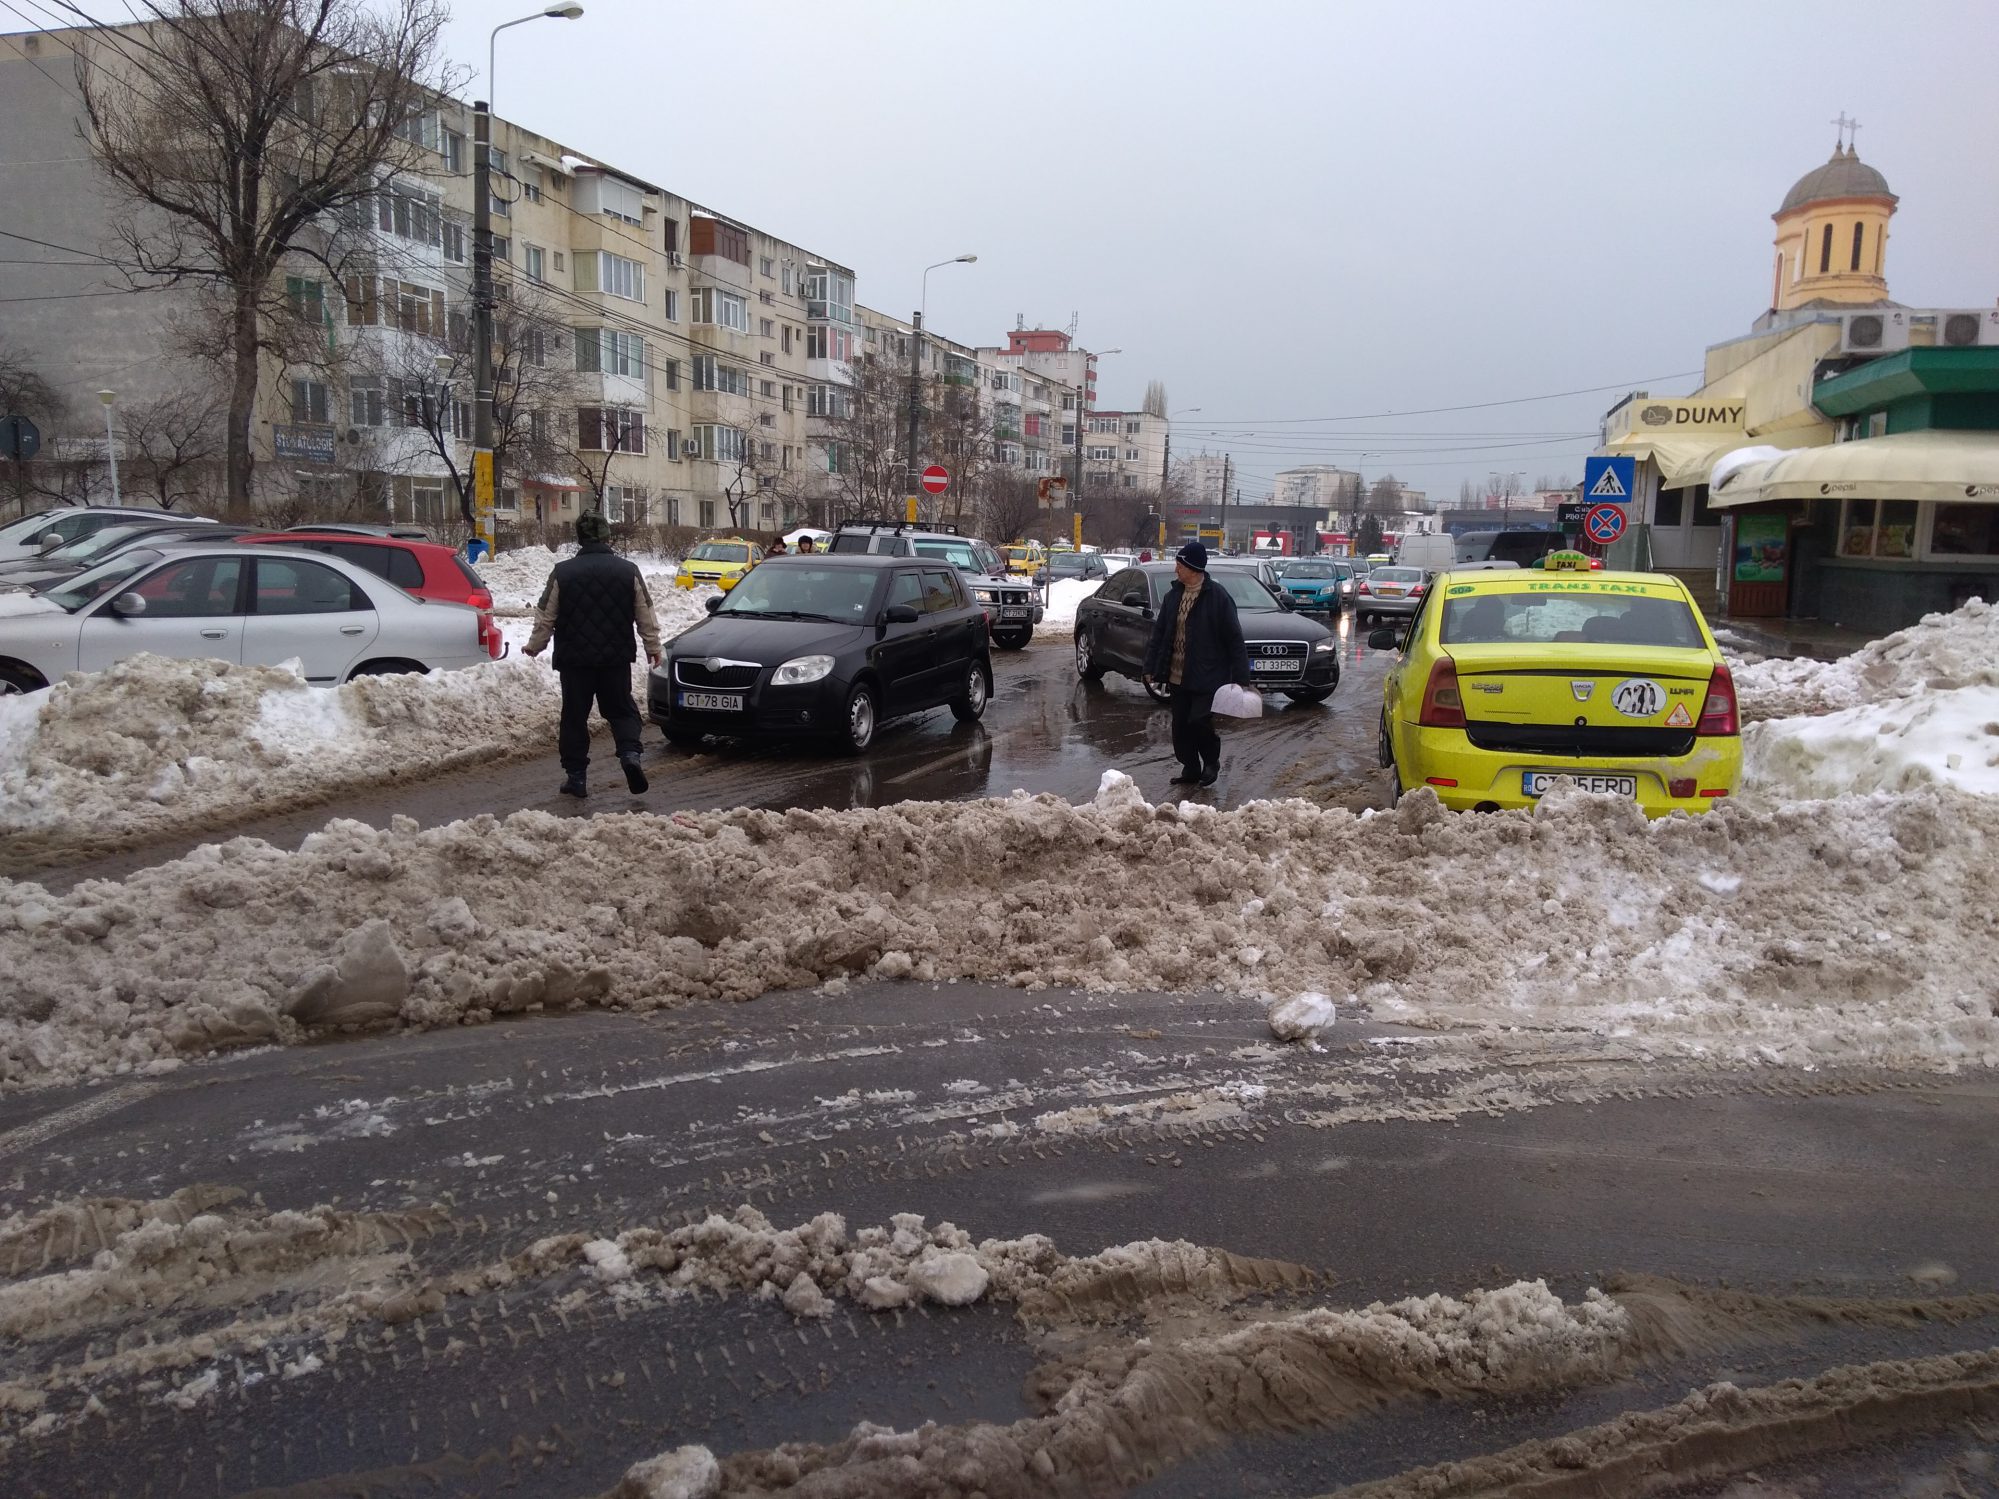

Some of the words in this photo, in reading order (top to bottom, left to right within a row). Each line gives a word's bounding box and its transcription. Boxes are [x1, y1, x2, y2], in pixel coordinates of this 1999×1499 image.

[1675, 406, 1743, 424] DUMY
[1832, 482, 1857, 492] pepsi
[1556, 561, 1577, 569] TAXI
[1528, 582, 1591, 591] TRANS
[1599, 584, 1647, 594] TAXI
[1255, 661, 1266, 670] CT
[687, 694, 701, 706] CT
[721, 696, 739, 709] GIA
